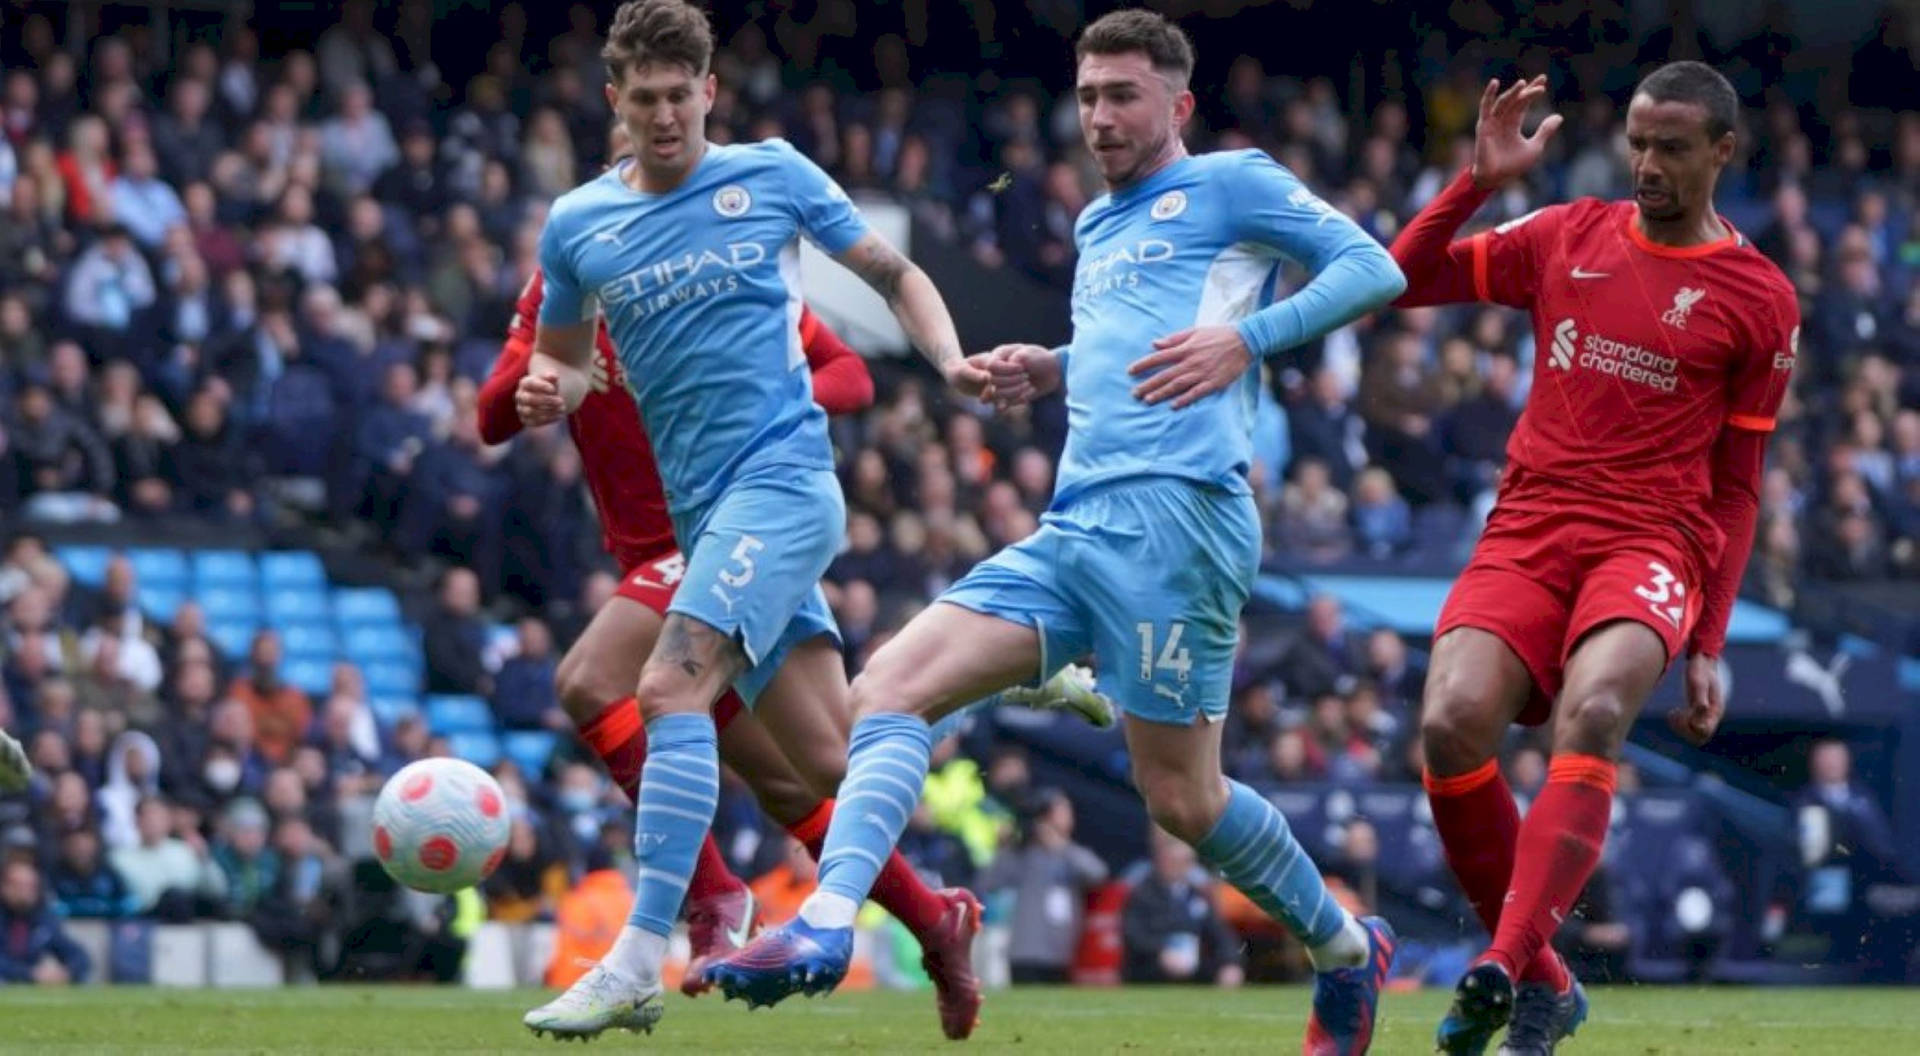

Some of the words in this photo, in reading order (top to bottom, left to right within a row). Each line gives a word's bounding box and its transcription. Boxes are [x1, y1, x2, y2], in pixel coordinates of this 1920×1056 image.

[601, 242, 765, 304] ETIHAD
[632, 275, 738, 319] AIRWAYS
[1580, 351, 1677, 392] chartered
[1584, 334, 1678, 373] standard
[718, 534, 765, 588] 5
[1136, 622, 1192, 681] 14
